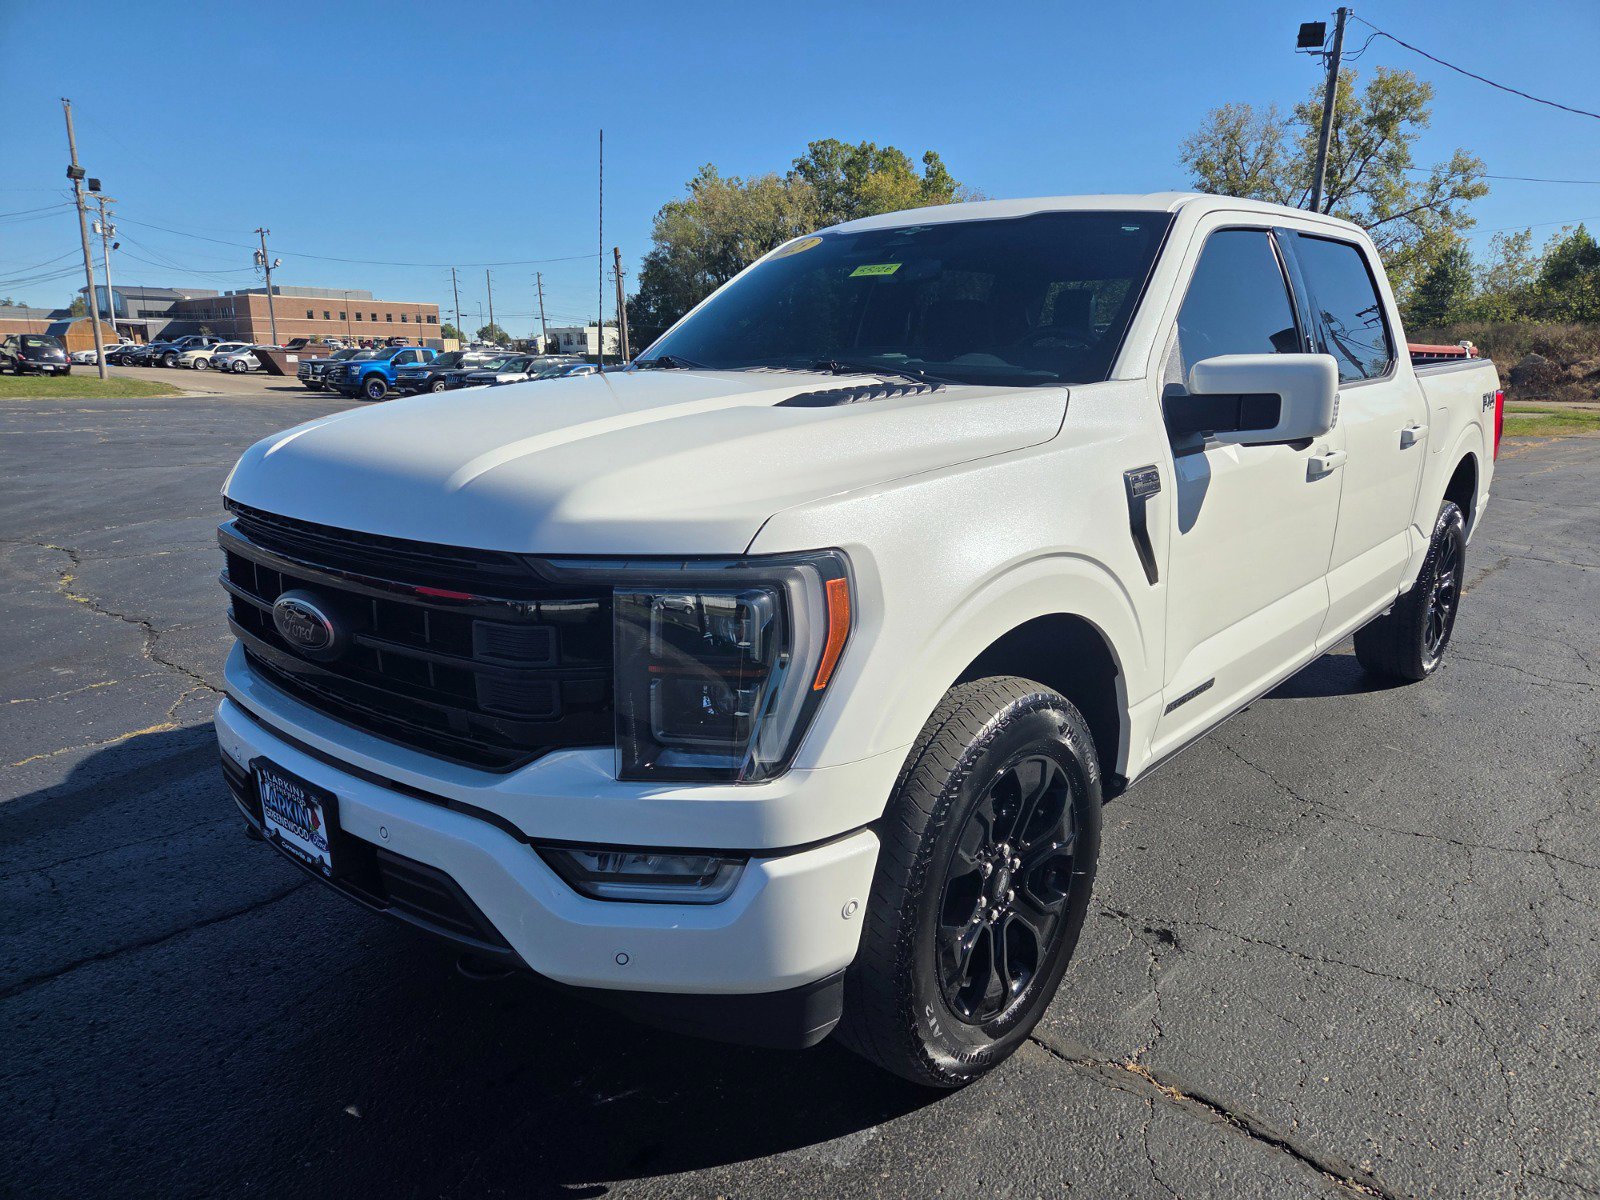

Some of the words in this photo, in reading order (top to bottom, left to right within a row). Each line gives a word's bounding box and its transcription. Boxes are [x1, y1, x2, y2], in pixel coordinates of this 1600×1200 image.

[282, 608, 315, 642] Ford
[260, 782, 310, 830] LARKIN
[265, 806, 310, 841] GREENEWOOD
